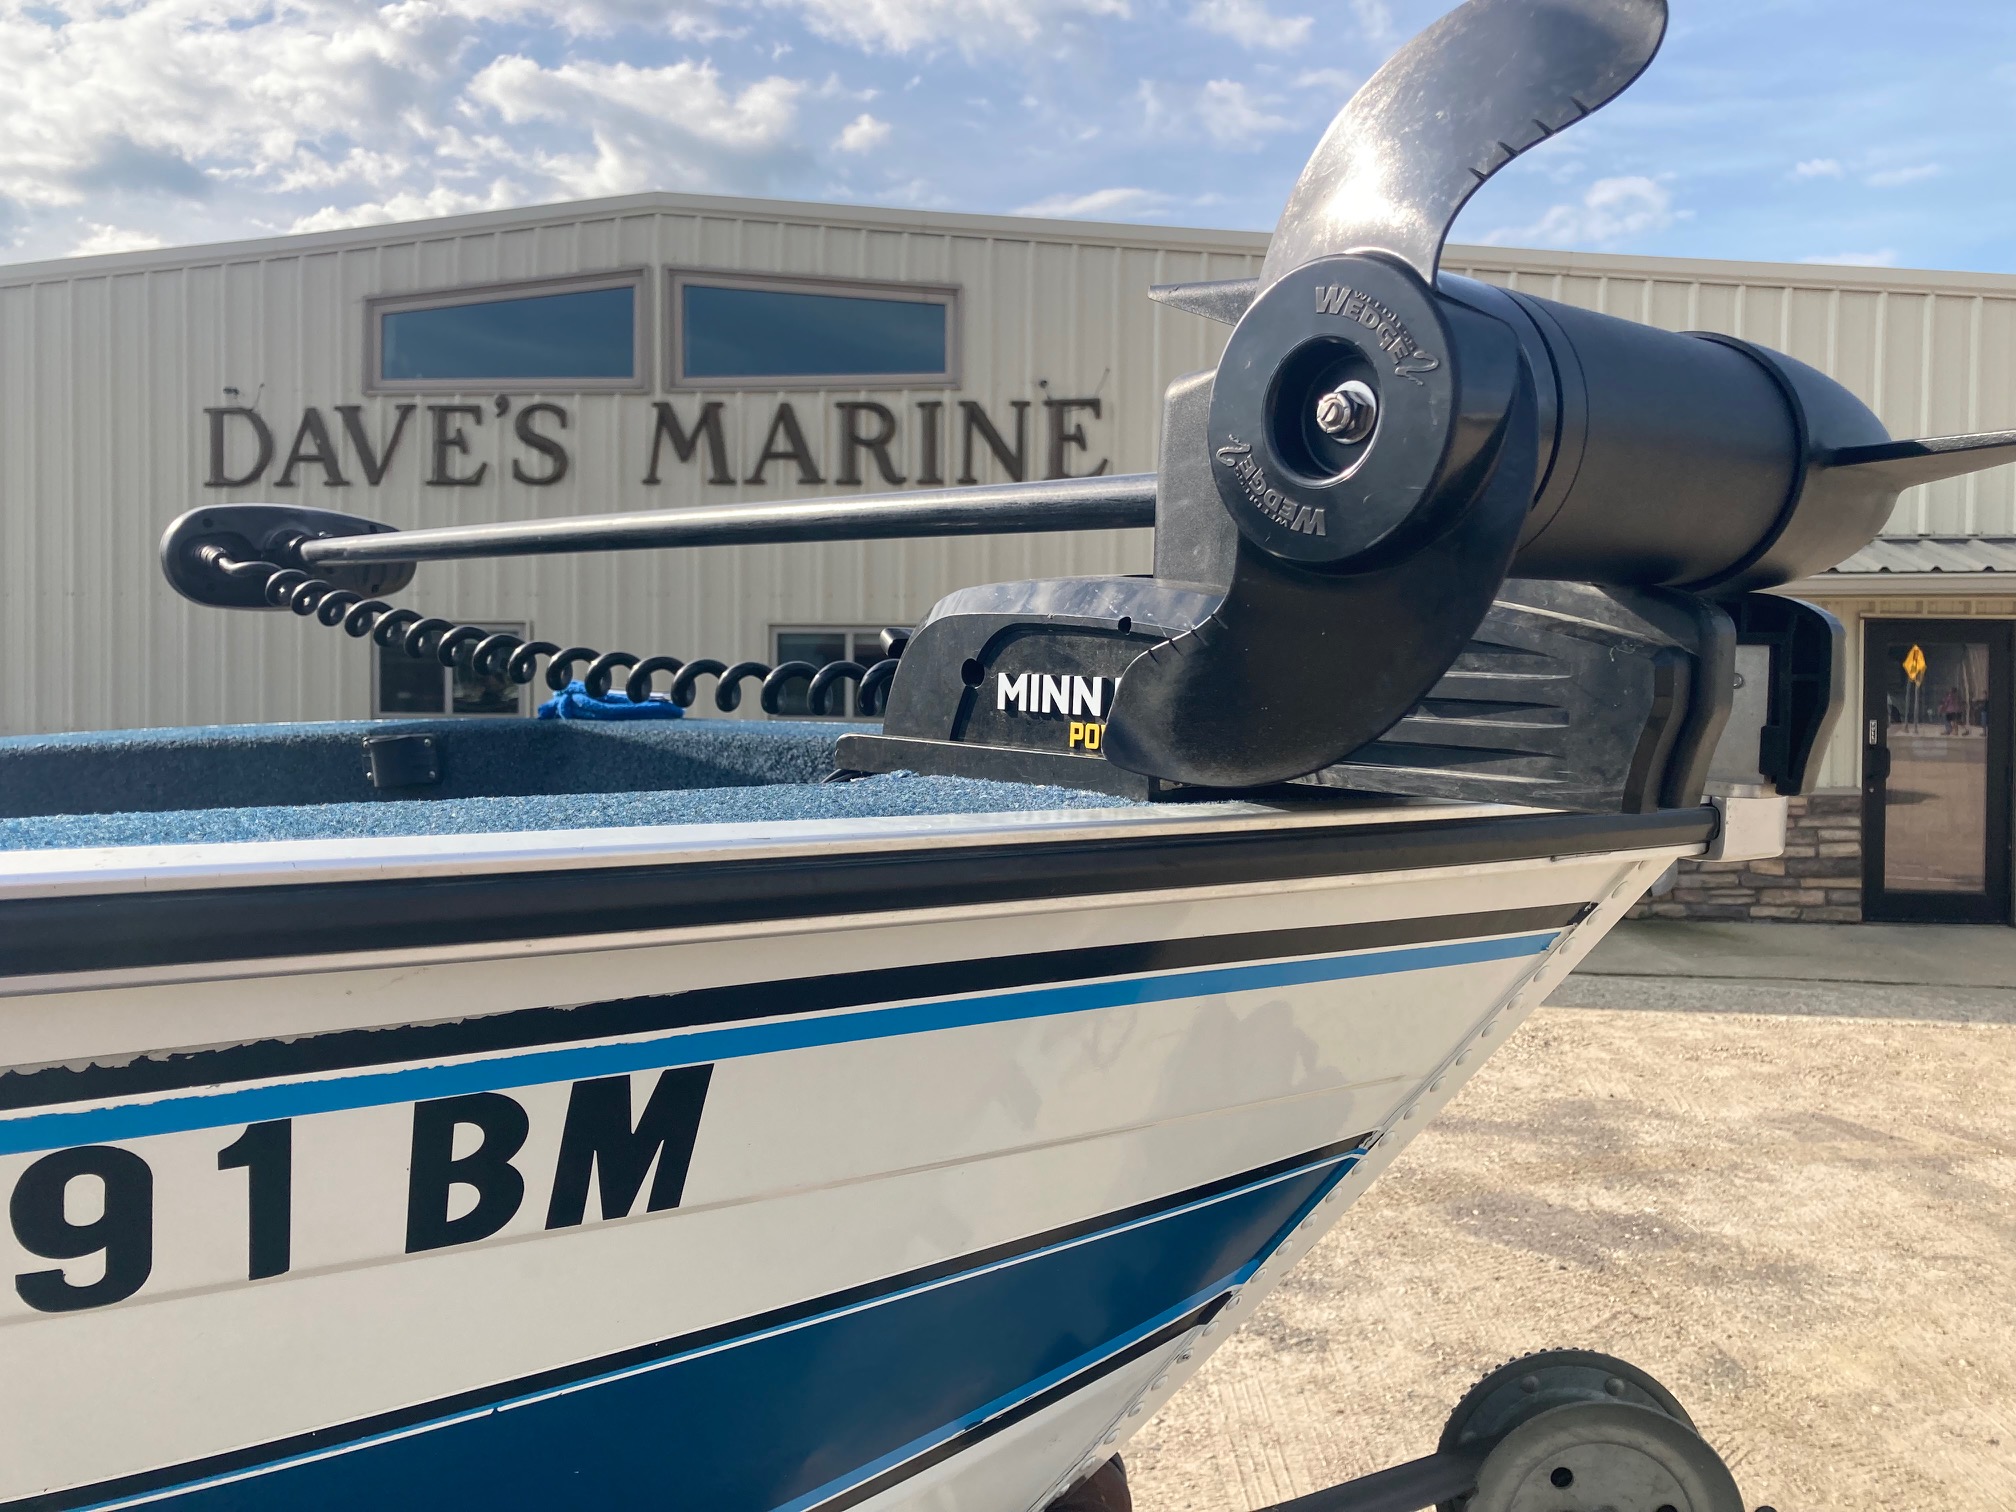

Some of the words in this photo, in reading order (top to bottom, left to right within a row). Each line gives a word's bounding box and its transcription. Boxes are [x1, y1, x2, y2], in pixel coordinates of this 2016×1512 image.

[1315, 284, 1411, 366] WEDGE
[203, 395, 570, 488] DAVE'S
[641, 397, 1109, 487] MARINE
[1236, 452, 1327, 537] WEDGE
[997, 672, 1102, 717] MINN
[9, 1118, 292, 1313] 91
[405, 1063, 715, 1254] BM
